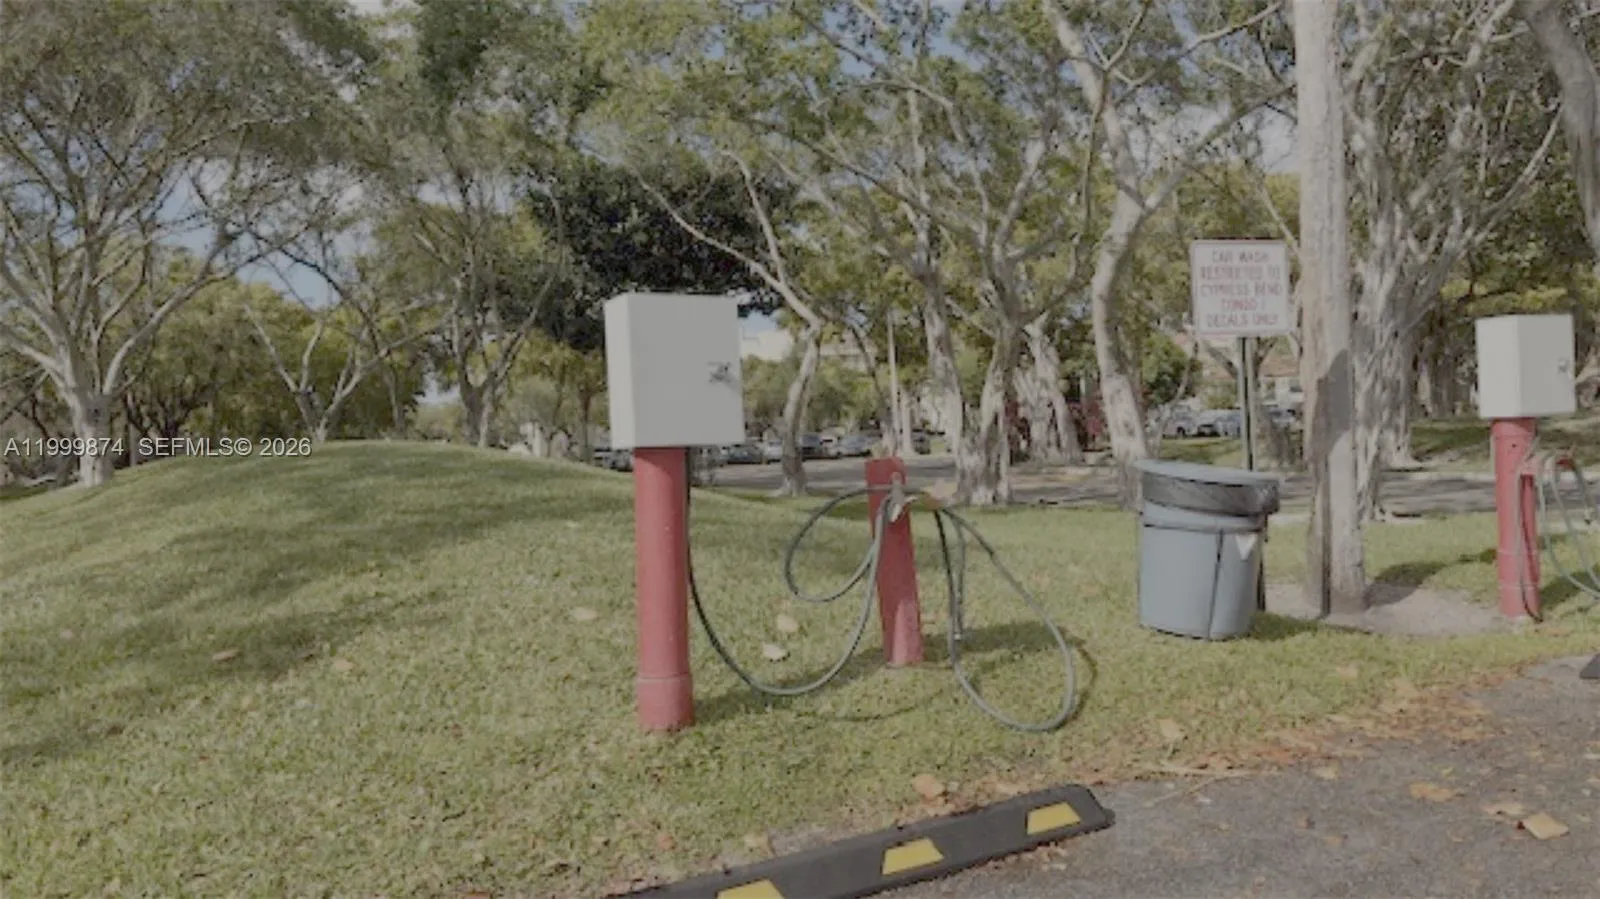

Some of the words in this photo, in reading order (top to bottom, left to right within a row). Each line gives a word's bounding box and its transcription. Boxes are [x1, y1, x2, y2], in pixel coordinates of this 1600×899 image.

[1212, 250, 1234, 262] CAR
[1239, 250, 1269, 262] WASH
[1200, 282, 1249, 296] CYPRESS
[1254, 281, 1281, 296] BEND
[1206, 313, 1248, 328] DECALS
[1253, 312, 1279, 326] ONLY
